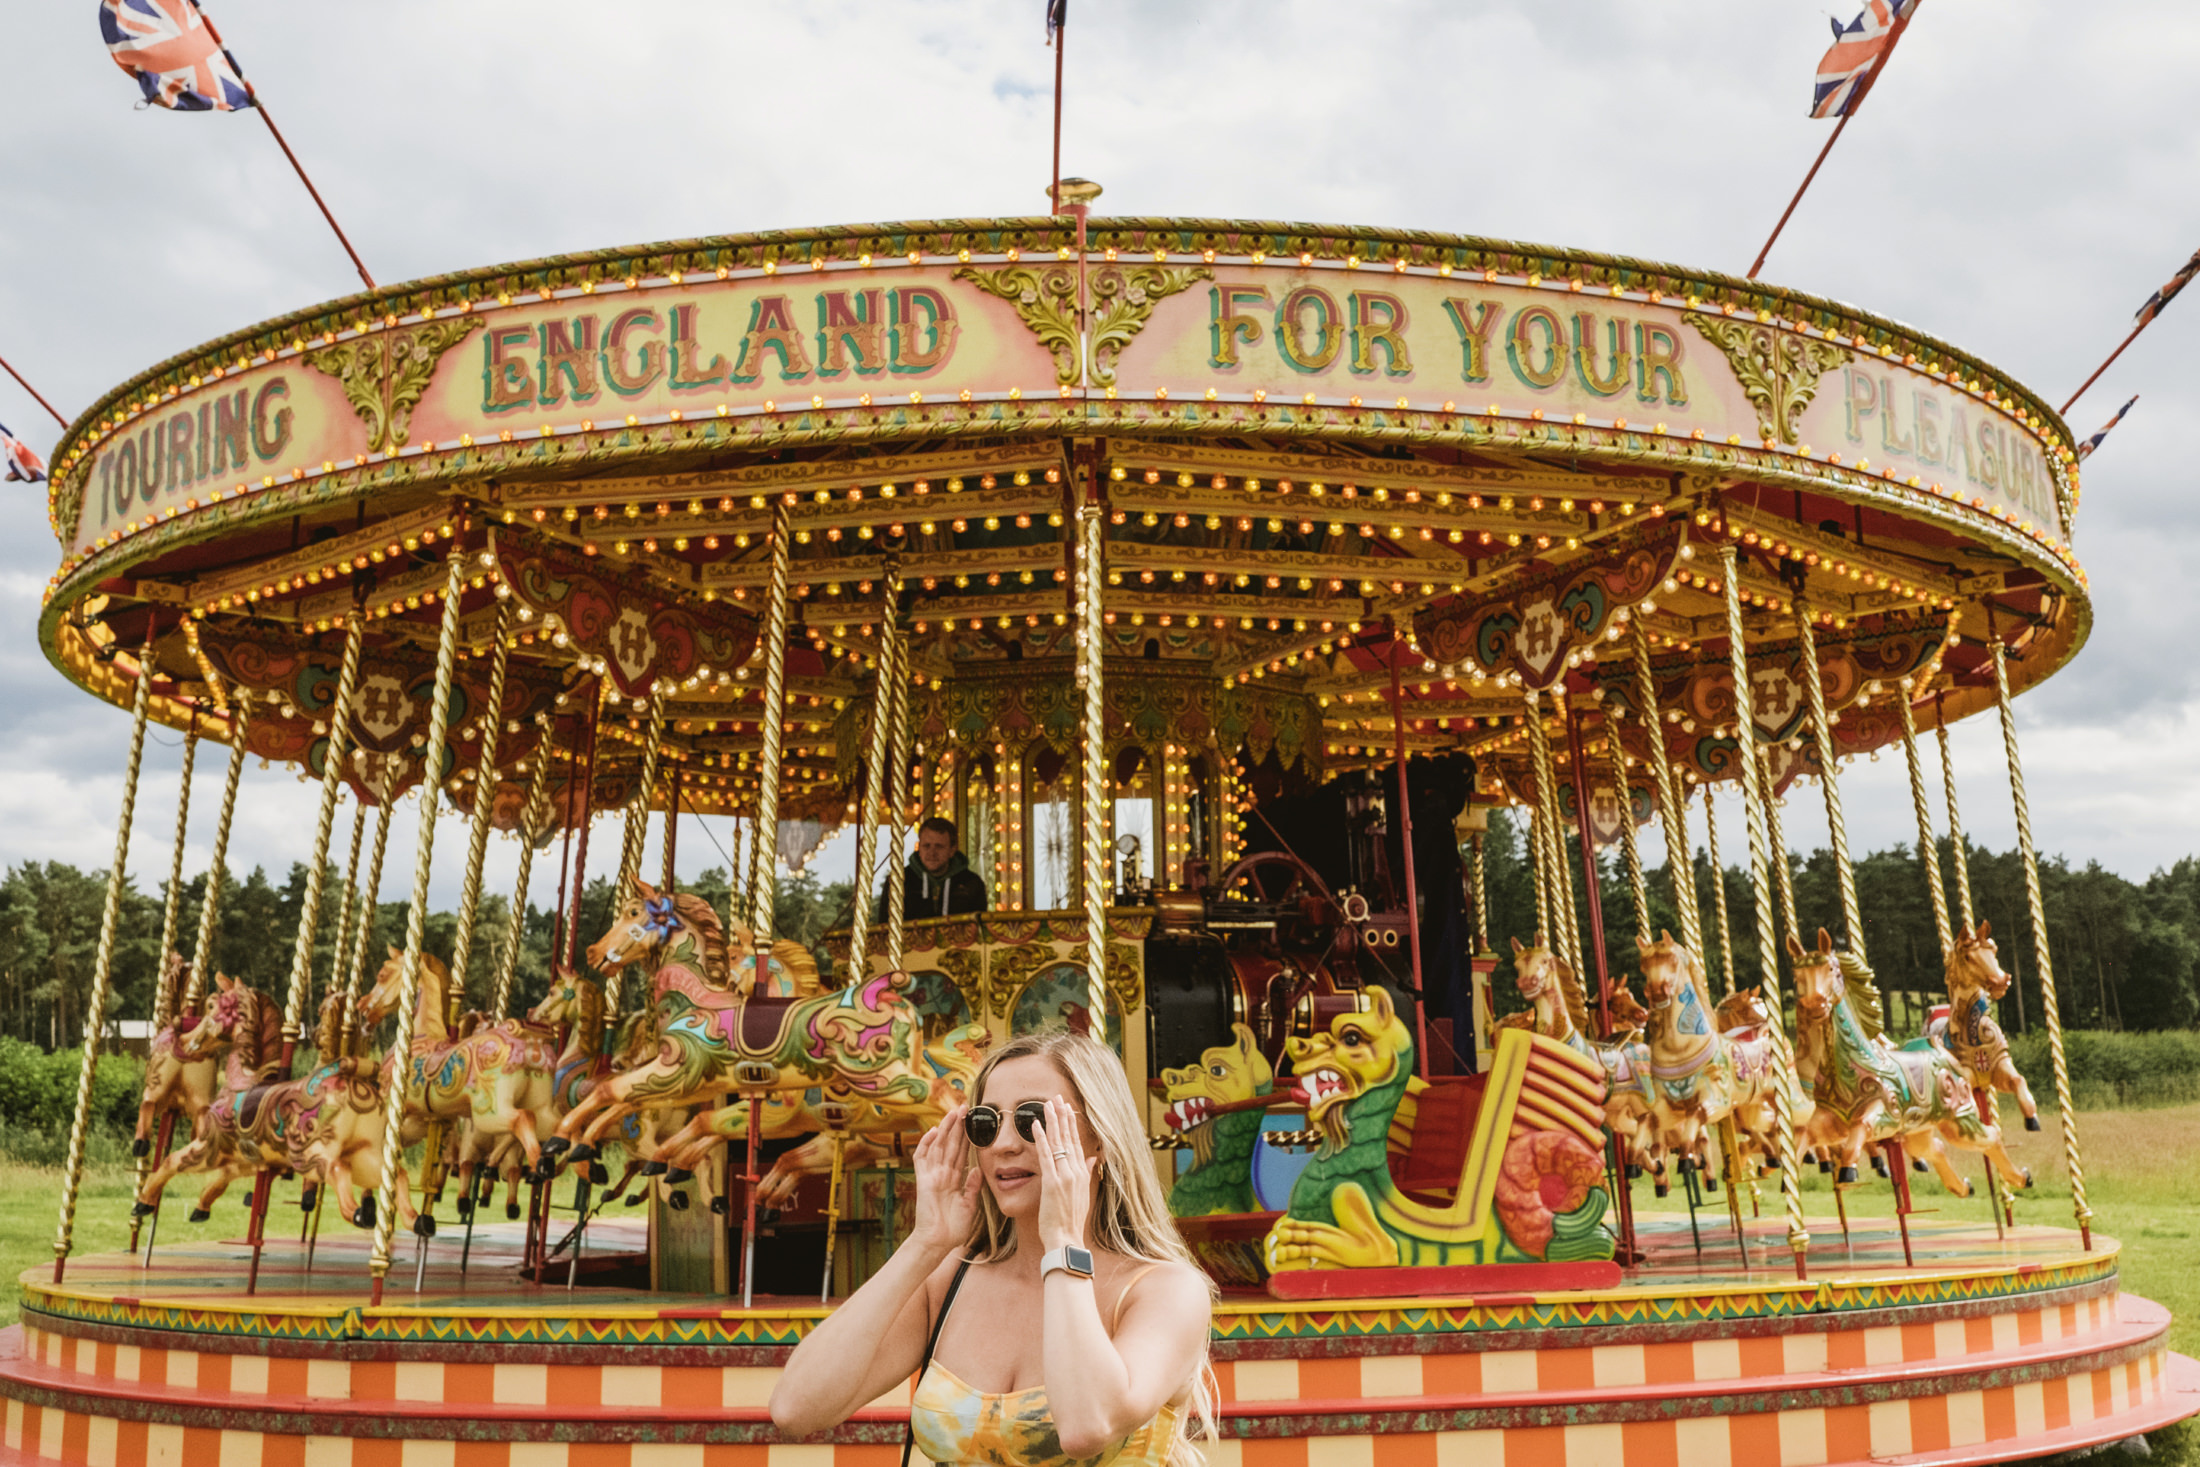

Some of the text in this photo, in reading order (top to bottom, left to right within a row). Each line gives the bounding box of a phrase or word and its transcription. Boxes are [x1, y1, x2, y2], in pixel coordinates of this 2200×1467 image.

[100, 284, 2051, 528] TOURING ENGLAND FOR YOUR PLEASURE
[619, 619, 648, 668] H
[1524, 612, 1554, 659] H
[363, 686, 402, 726] H
[1753, 678, 1790, 716] H
[1595, 796, 1617, 823] H
